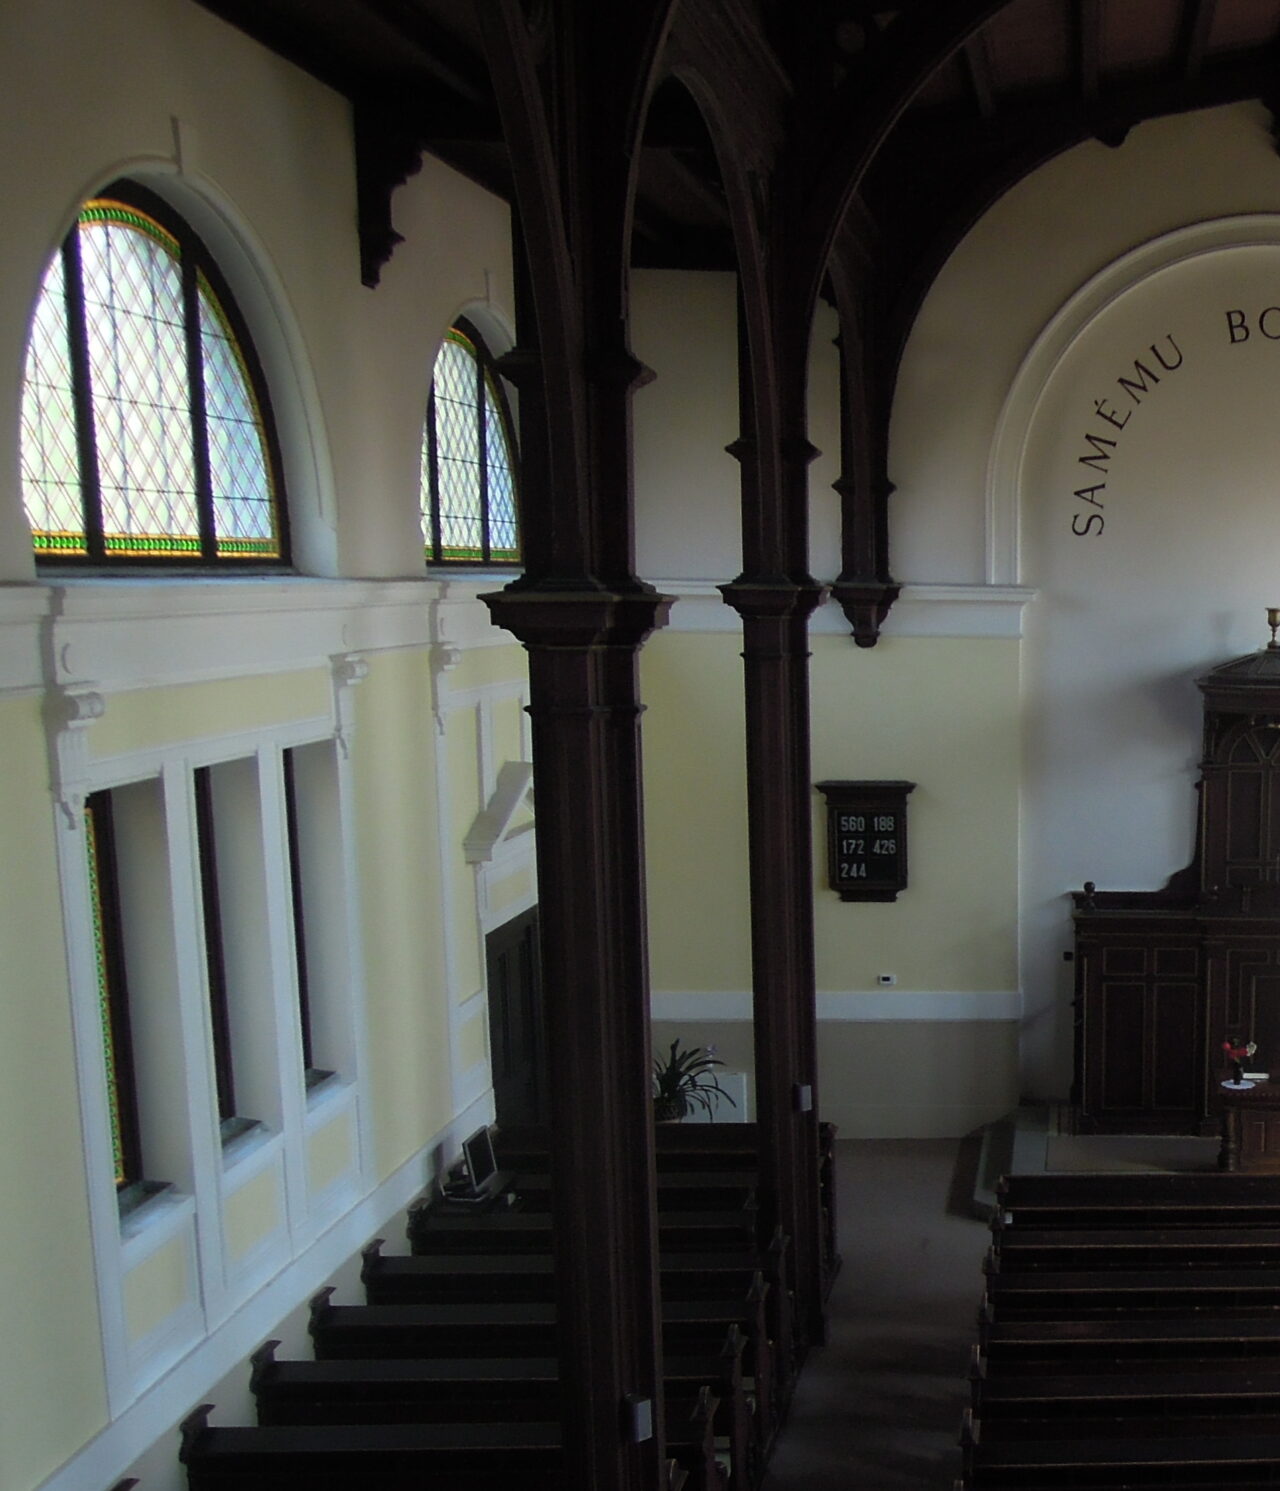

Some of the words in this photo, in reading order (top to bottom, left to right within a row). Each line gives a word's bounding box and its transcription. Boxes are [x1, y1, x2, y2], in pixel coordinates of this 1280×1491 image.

[1071, 333, 1184, 537] SAMÉMU
[840, 816, 865, 832] 560
[873, 816, 895, 832] 188
[842, 839, 865, 855] 172
[872, 839, 897, 855] 426
[840, 863, 867, 878] 244
